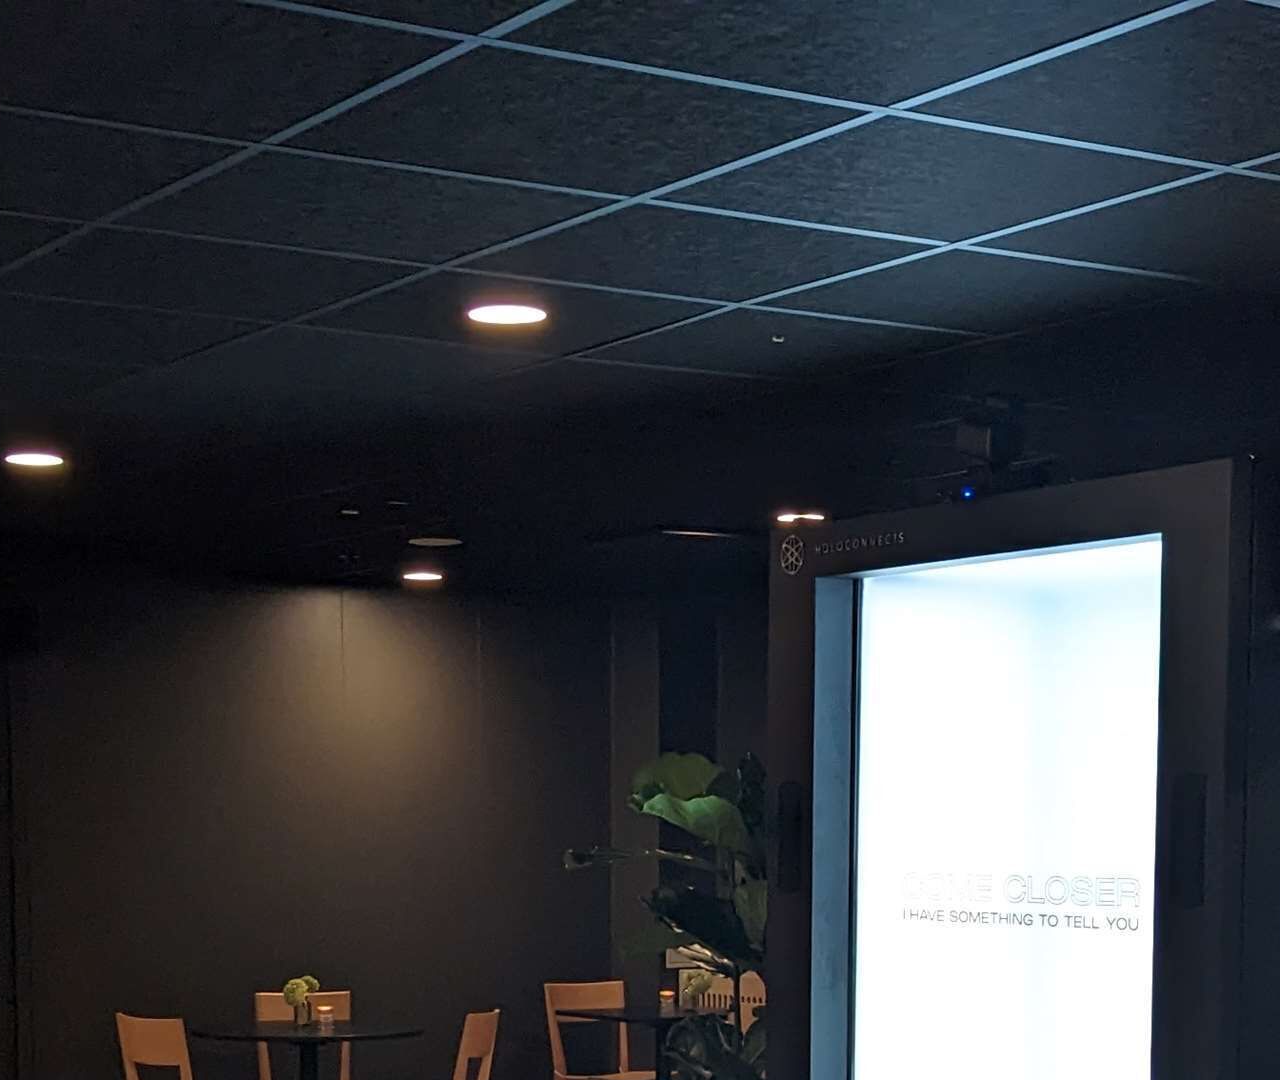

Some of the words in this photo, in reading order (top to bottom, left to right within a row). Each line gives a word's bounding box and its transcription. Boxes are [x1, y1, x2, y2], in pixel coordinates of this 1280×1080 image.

[1004, 874, 1140, 908] CLOSER
[909, 908, 945, 922] HAVE
[949, 910, 1034, 927] SOMETHING
[1038, 913, 1060, 928] TO
[1064, 914, 1100, 930] TELL
[1105, 916, 1140, 932] YOU
